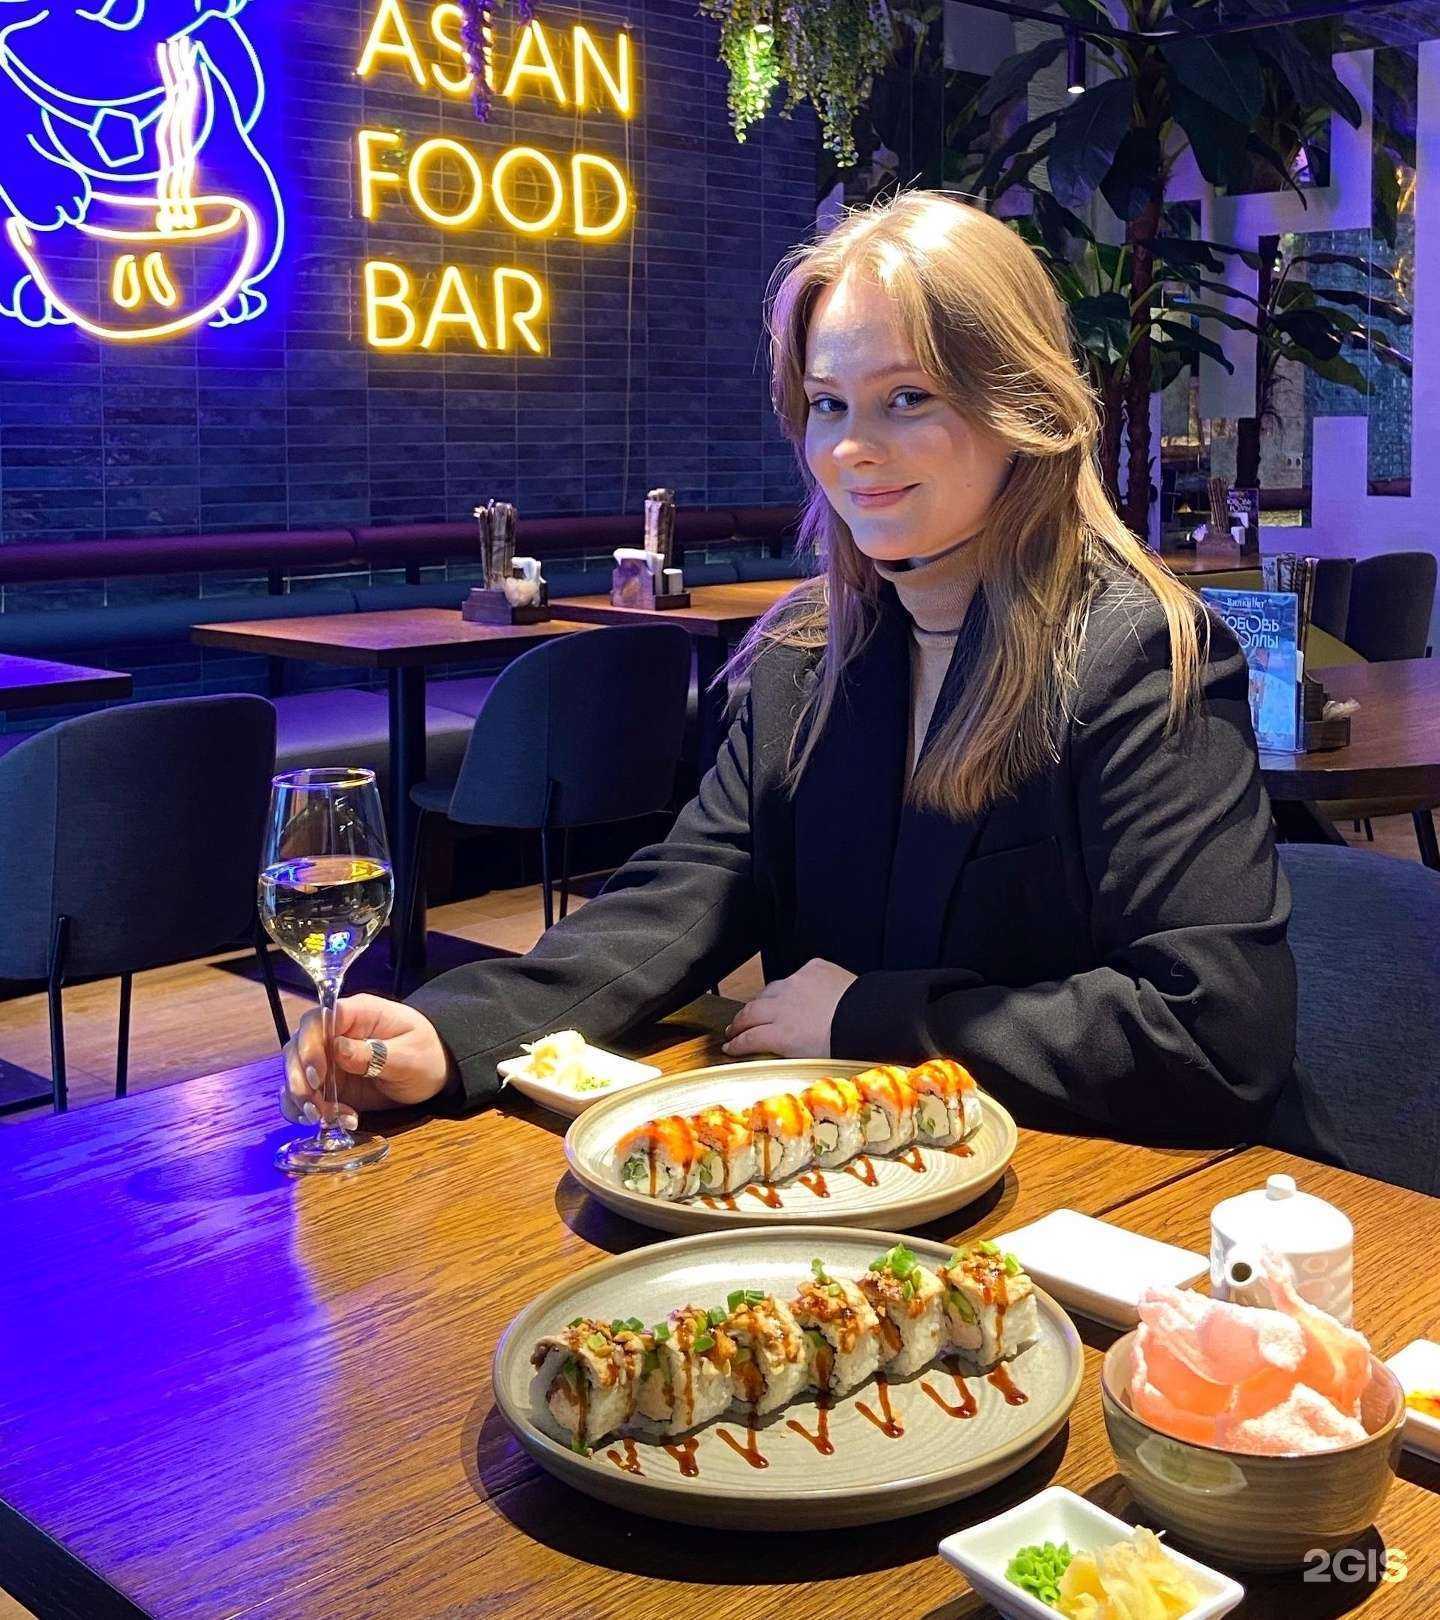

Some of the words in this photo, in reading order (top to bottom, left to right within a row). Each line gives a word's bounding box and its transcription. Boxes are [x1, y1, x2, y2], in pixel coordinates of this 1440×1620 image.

[356, 0, 632, 114] ASIAN
[357, 129, 629, 237] FOOD
[364, 261, 543, 354] BAR
[1238, 630, 1280, 648] ОЛЛЫ
